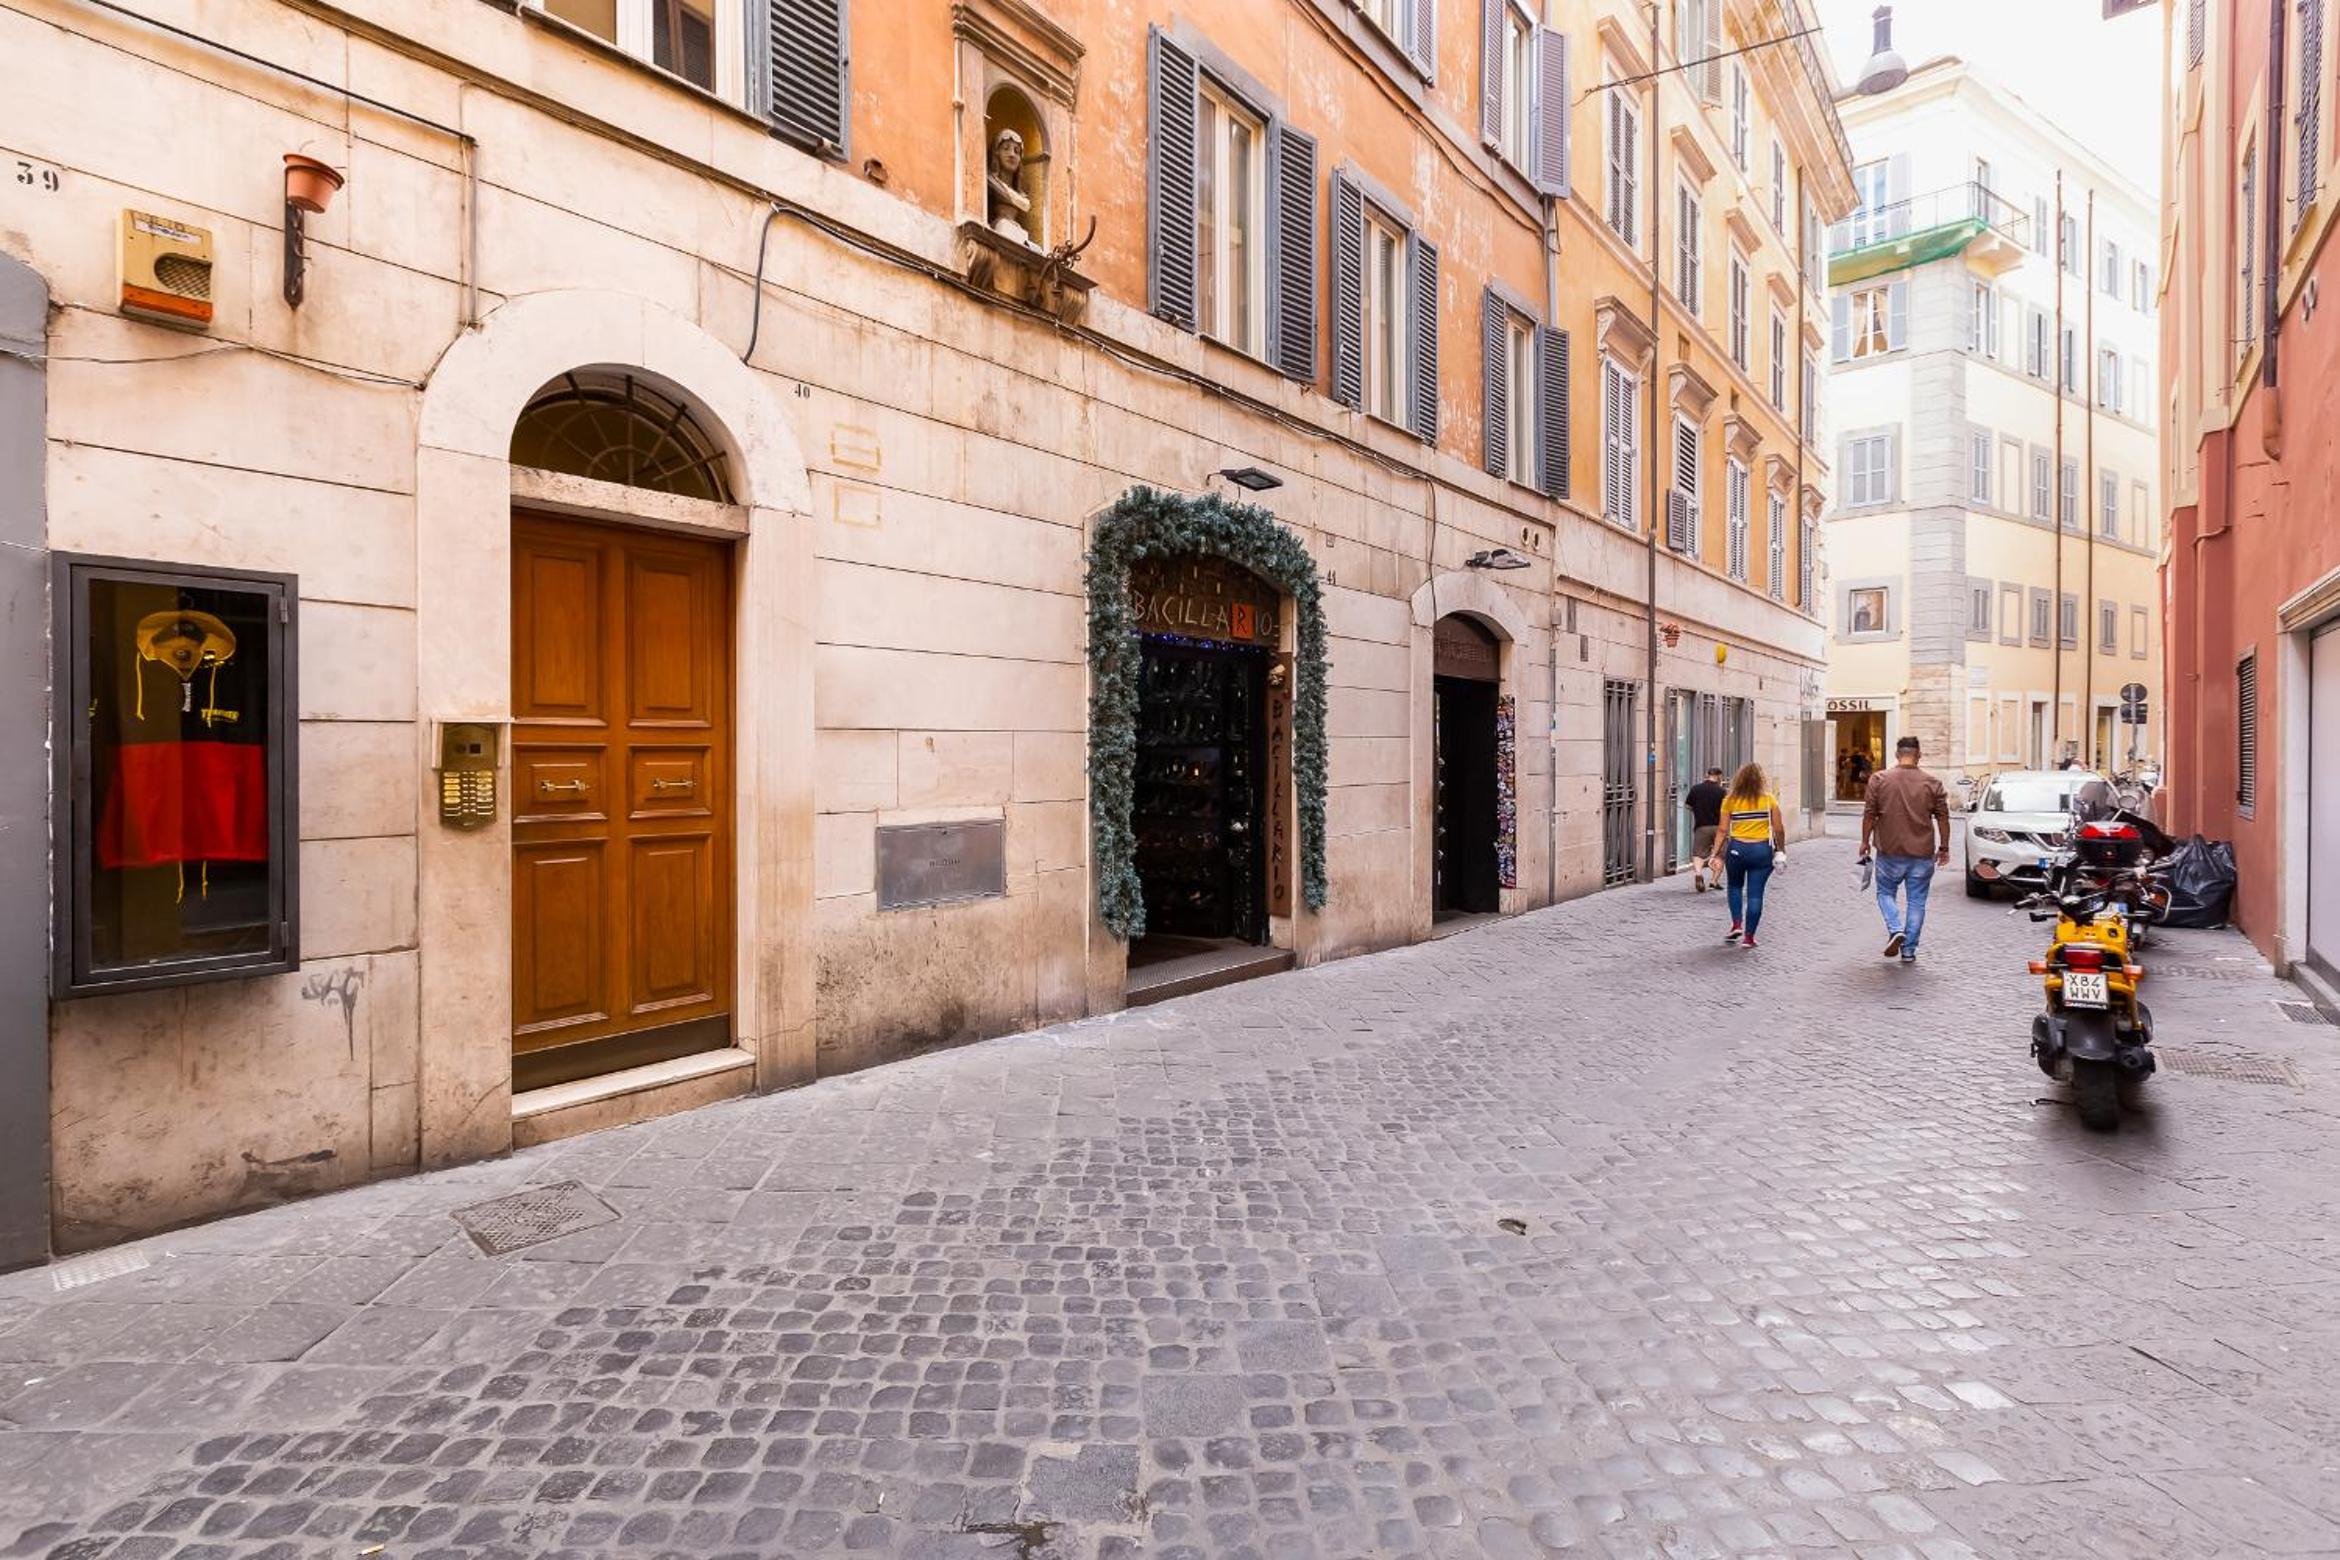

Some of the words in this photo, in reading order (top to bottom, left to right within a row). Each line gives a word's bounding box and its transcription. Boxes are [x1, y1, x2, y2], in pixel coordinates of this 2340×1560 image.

[17, 161, 59, 192] 39
[794, 383, 811, 399] 40
[1133, 589, 1272, 636] BACILLARIO
